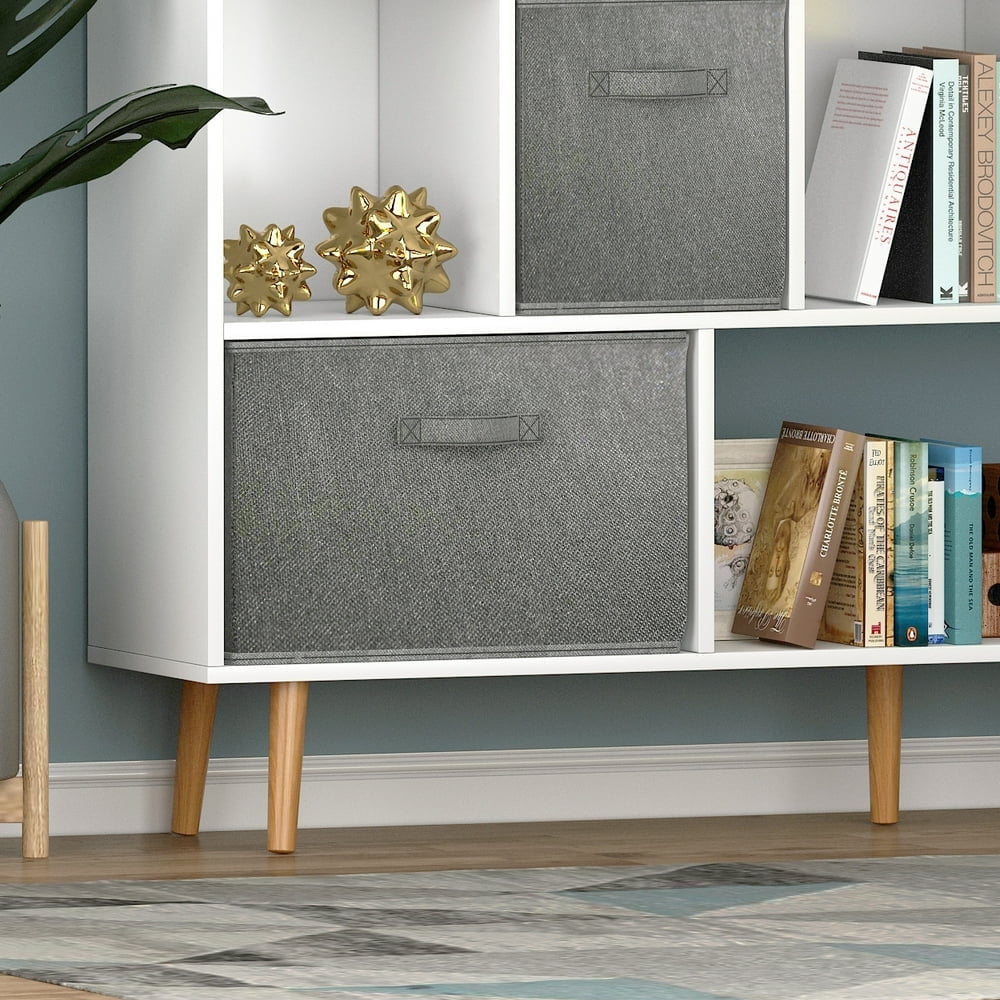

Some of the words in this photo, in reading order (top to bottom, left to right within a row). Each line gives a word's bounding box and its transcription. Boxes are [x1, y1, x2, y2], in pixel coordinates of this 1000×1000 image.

[938, 82, 946, 108] Virginia
[947, 81, 955, 101] Detail
[948, 102, 955, 110] in
[977, 61, 994, 143] ALEXEY
[938, 109, 946, 138] McLeod
[946, 111, 955, 160] Contemporary
[880, 127, 917, 244] ANTIQUAIRES
[977, 150, 994, 286] BRODOVITCH
[804, 430, 836, 444] CHARLOTTE
[909, 454, 917, 485] Robinson
[874, 475, 885, 516] PIRATES
[909, 487, 917, 512] Crusoe
[819, 504, 839, 558] CHARLOTTE
[875, 517, 885, 532] OF
[876, 535, 885, 554] THE
[874, 555, 885, 611] CARIBBEAN
